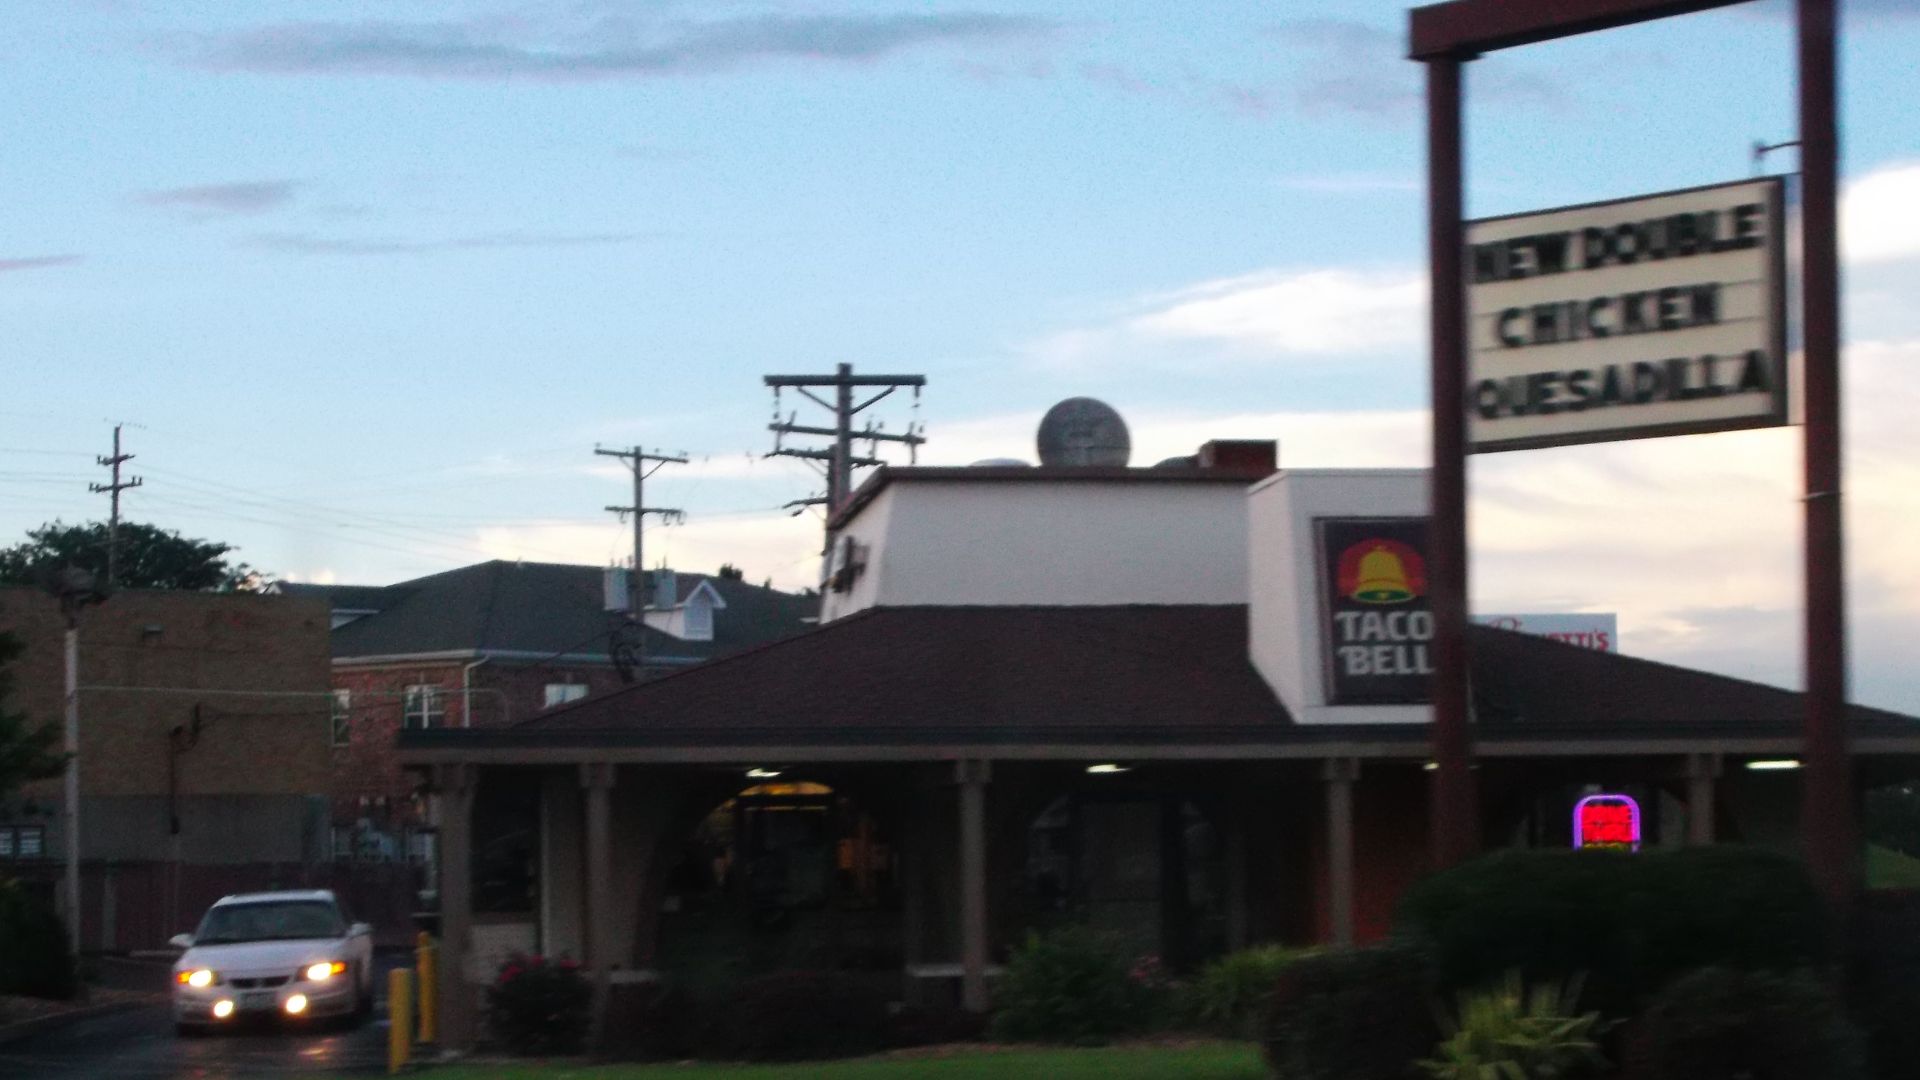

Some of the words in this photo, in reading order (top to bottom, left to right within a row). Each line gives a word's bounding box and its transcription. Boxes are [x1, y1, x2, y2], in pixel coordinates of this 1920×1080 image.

[1465, 230, 1572, 284] NEW
[1582, 202, 1765, 270] DOUBLE
[1497, 282, 1721, 348] CHICKEN
[1473, 349, 1769, 419] QUESADILLA
[1334, 610, 1435, 641] TACO
[1336, 644, 1437, 675] BELL
